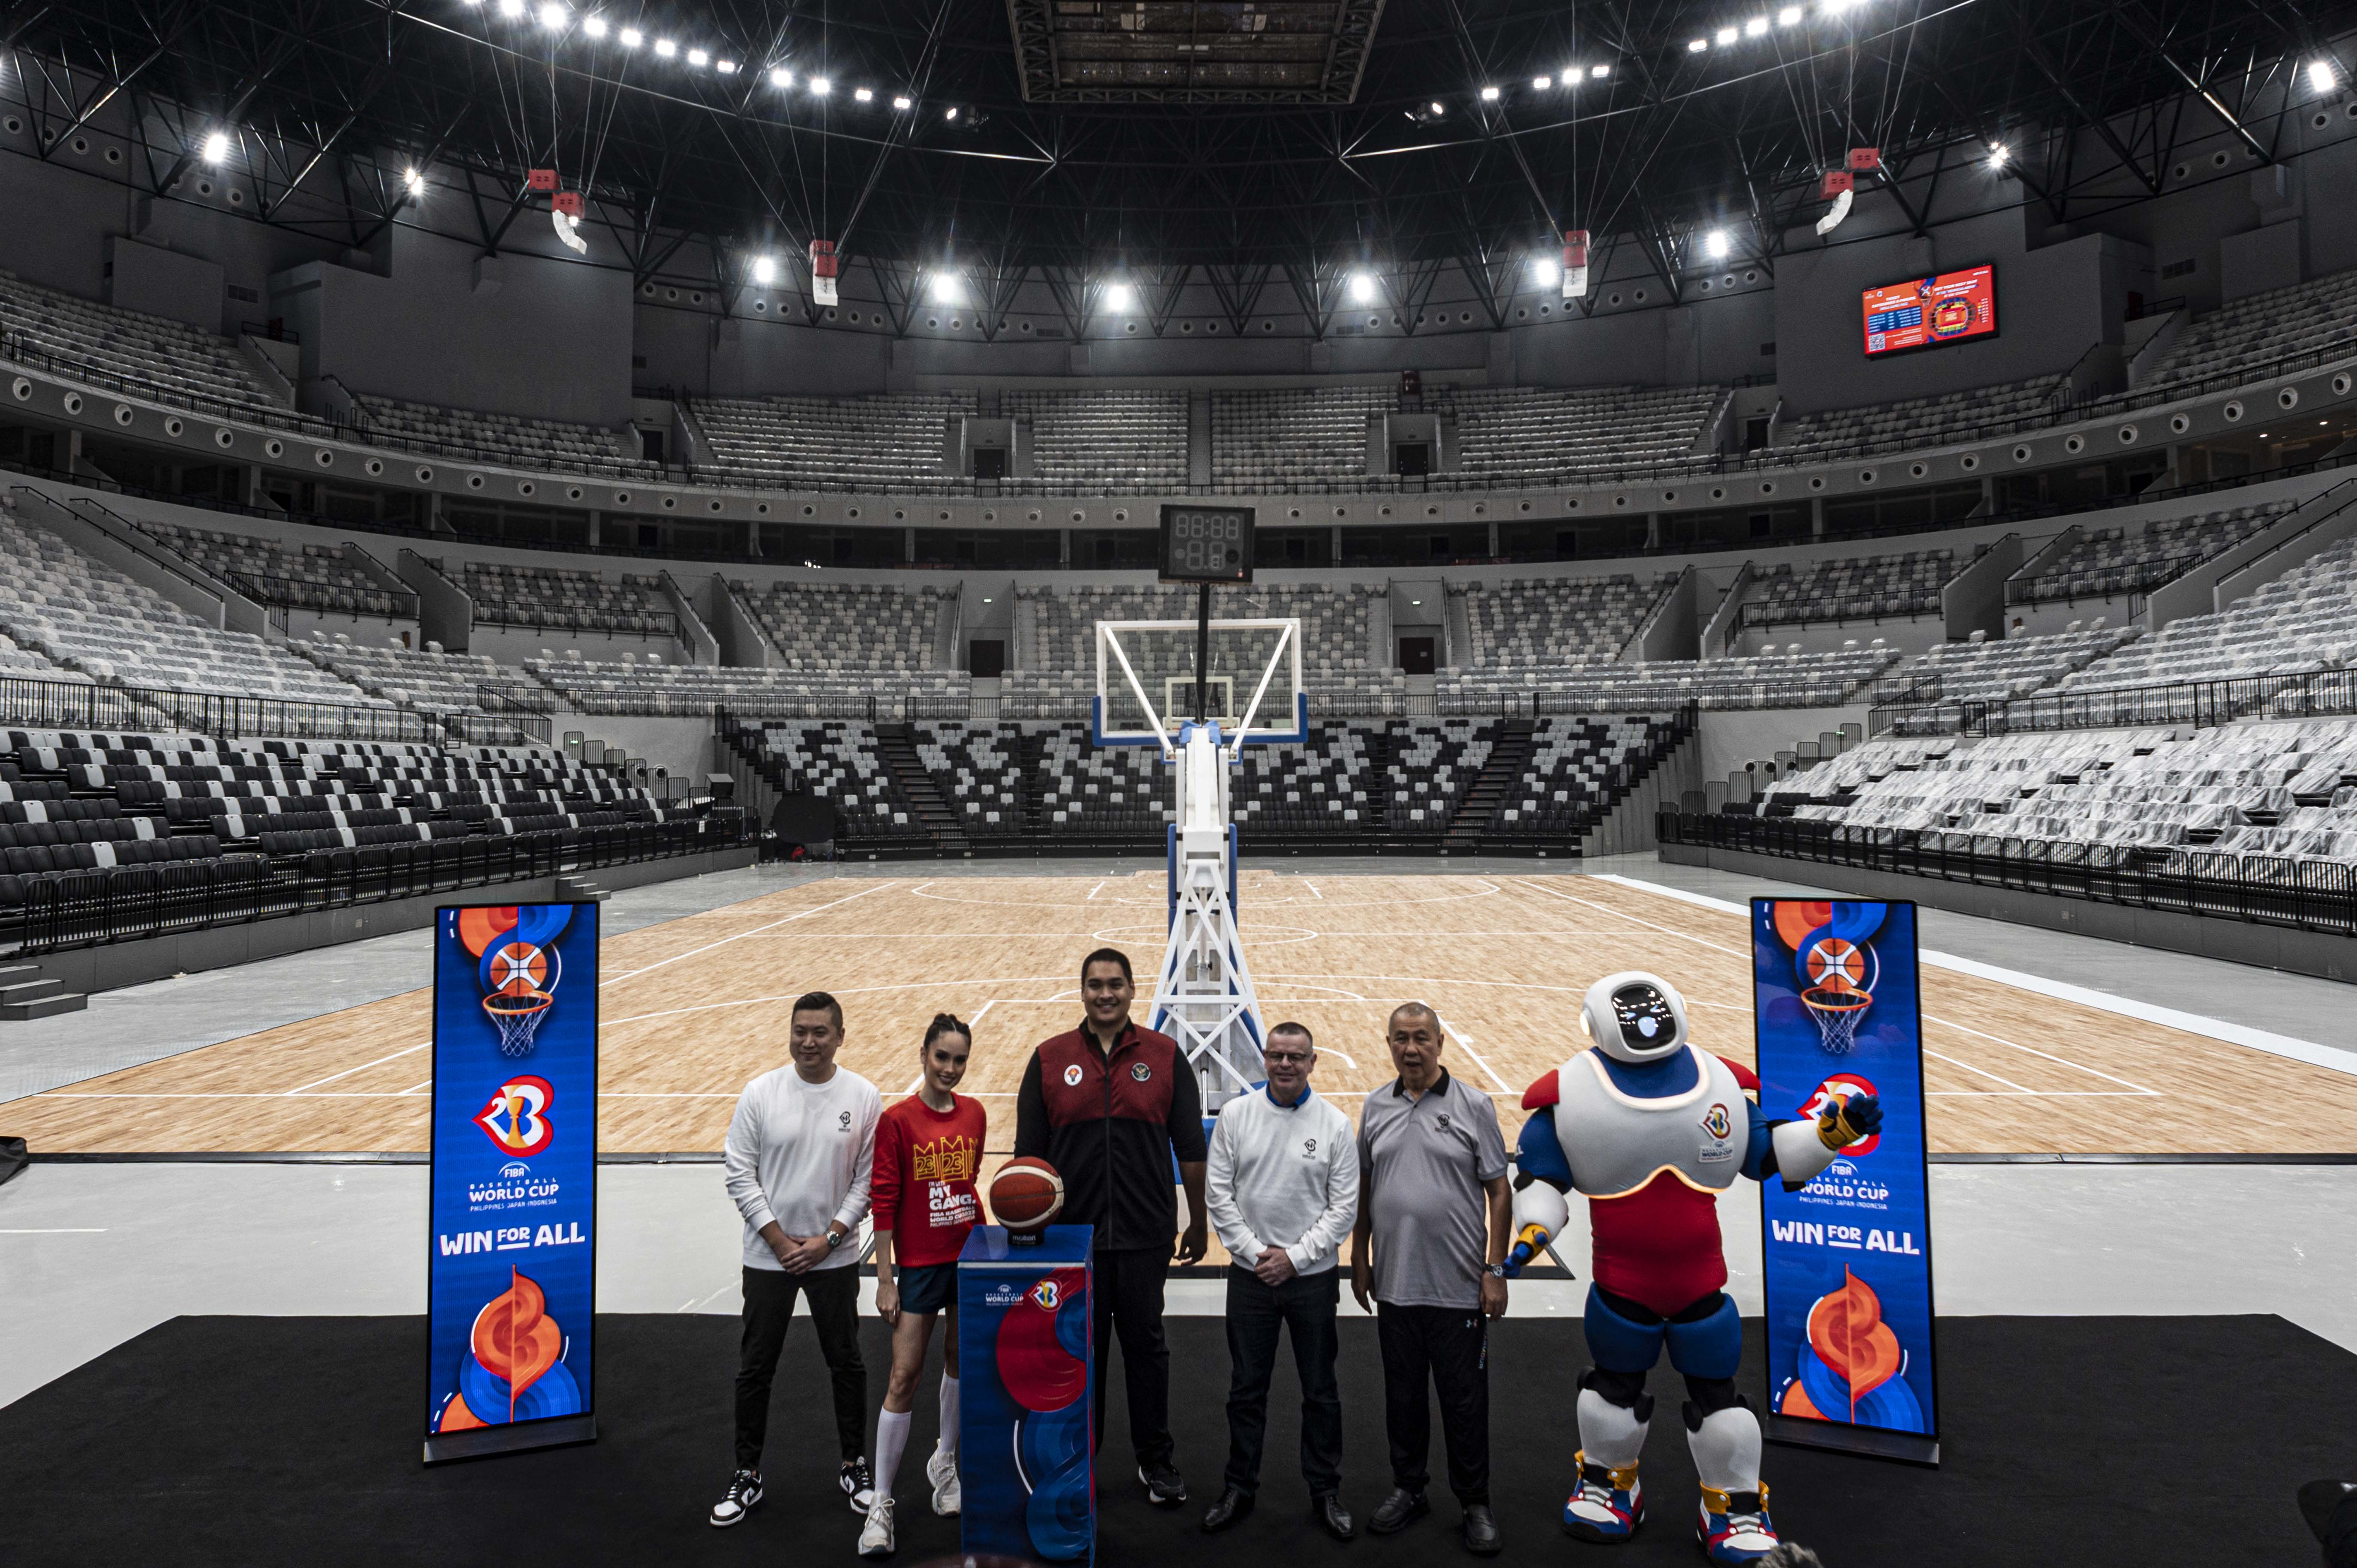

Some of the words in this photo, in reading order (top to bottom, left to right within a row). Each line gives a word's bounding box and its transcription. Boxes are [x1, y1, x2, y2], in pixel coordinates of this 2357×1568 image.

[504, 1167, 525, 1178] FIBA
[1831, 1165, 1852, 1175] FIBA
[470, 1177, 557, 1190] BASKETBALL
[1811, 1175, 1886, 1187] SKETBALL
[469, 1187, 525, 1202] WORLD
[528, 1184, 560, 1197] CUP
[929, 1184, 951, 1199] MY
[1800, 1182, 1854, 1198] WORLD
[1857, 1187, 1889, 1200] CUP
[470, 1202, 504, 1212] PHILIPPINES
[507, 1200, 525, 1209] JAPAN
[528, 1198, 557, 1207] INDONESIA
[930, 1194, 976, 1210] GANG.
[1799, 1196, 1833, 1205] PHILIPPINES
[1856, 1201, 1888, 1210] INDONESIA
[440, 1230, 492, 1256] WIN
[497, 1226, 531, 1242] FOR
[534, 1222, 585, 1247] ALL
[1772, 1220, 1823, 1246] WIN
[1827, 1225, 1862, 1241] FOR
[1865, 1229, 1920, 1255] ALL
